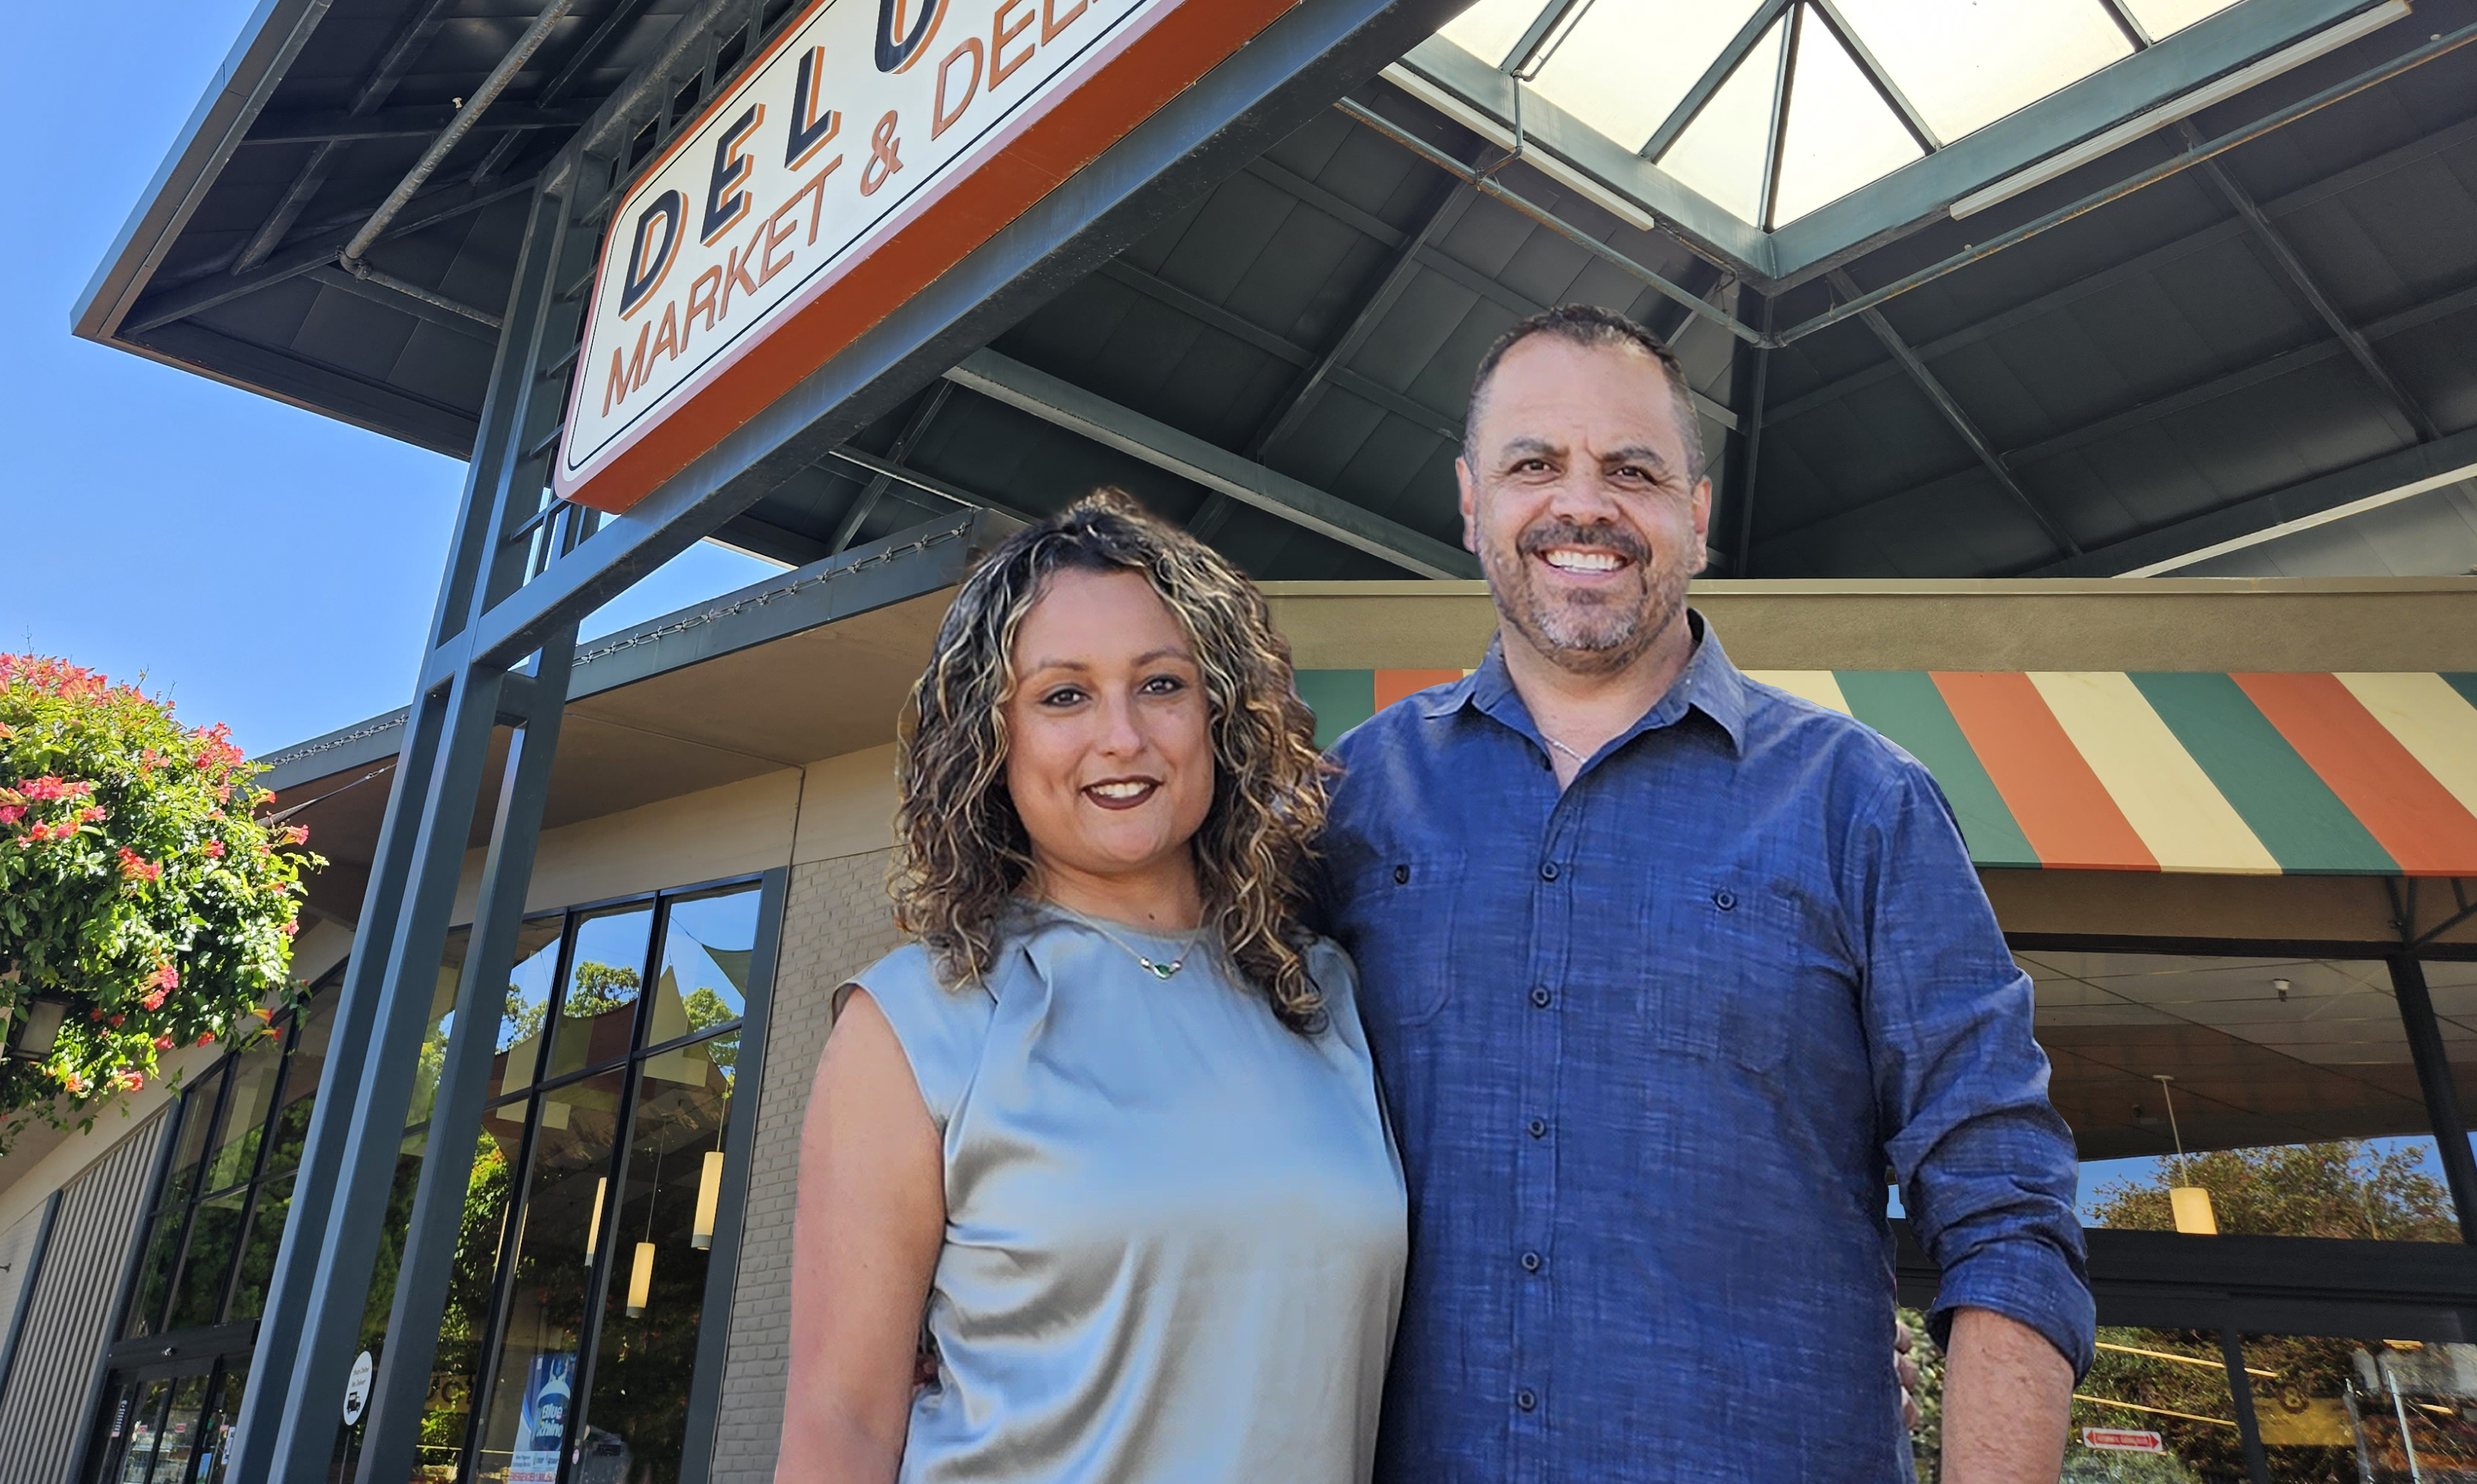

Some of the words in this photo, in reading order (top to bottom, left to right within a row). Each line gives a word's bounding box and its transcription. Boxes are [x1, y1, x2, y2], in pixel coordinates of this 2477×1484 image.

[601, 153, 843, 418] MARKET
[860, 109, 904, 197] &
[931, 0, 1099, 141] DEL
[542, 1403, 564, 1419] Blue
